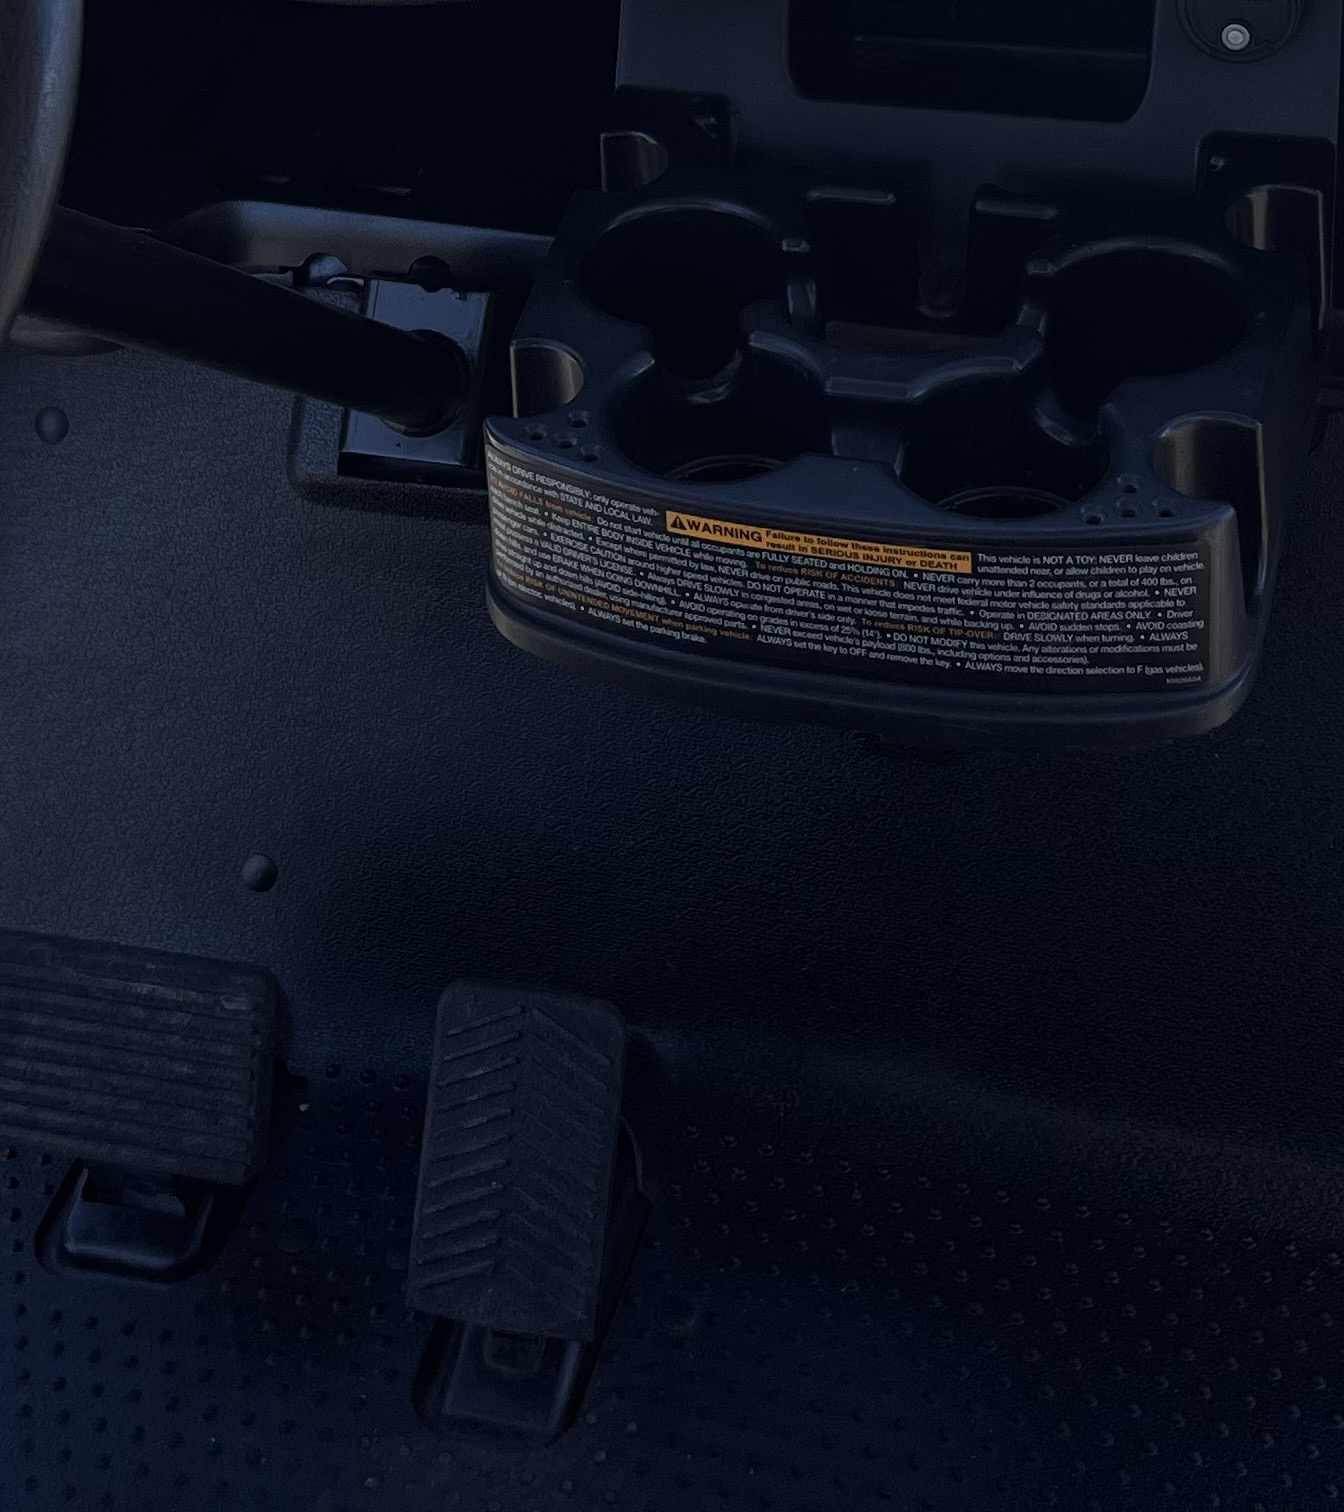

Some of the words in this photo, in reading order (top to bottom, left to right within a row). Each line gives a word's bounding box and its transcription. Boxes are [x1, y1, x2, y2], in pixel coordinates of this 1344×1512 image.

[603, 505, 630, 521] LOCAL
[686, 519, 762, 542] WARNING
[601, 527, 624, 542] BODY
[625, 534, 654, 549] INSIDE
[654, 541, 691, 557] VEHICLE
[903, 581, 935, 593] NEVER
[993, 588, 1020, 598] under
[1164, 586, 1196, 596] NEVER
[765, 529, 800, 542] Failure
[803, 535, 814, 544] to
[816, 537, 848, 549] follow
[851, 542, 879, 553] these
[948, 551, 969, 560] can
[766, 539, 795, 551] result
[810, 546, 859, 560] SERIOUS
[862, 553, 902, 565] INJURY
[919, 559, 957, 569] DEATH
[978, 553, 996, 563] This
[1042, 555, 1064, 564] NOT
[1098, 554, 1132, 564] NEVER
[589, 545, 626, 564] CAUTION
[746, 579, 760, 590] DO
[762, 582, 780, 594] NOT
[783, 585, 825, 600] OPERATE
[1026, 610, 1088, 620] DESIGNATED
[1090, 611, 1123, 620] AREAS
[1124, 610, 1151, 620] ONLY.
[717, 564, 748, 578] NEVER
[841, 583, 859, 594] This
[916, 592, 931, 602] not
[761, 551, 789, 564] FULLY
[791, 556, 827, 570] SEATED
[828, 561, 845, 572] and
[847, 564, 890, 578] HOLDING
[922, 572, 955, 584] NEVER
[956, 577, 980, 587] carry
[981, 578, 1005, 586] more
[1006, 577, 1027, 587] than
[1140, 577, 1158, 586] 400
[1179, 577, 1192, 585] on
[676, 576, 702, 590] DRIVE
[703, 581, 739, 596] SLOWLY
[1028, 621, 1057, 631] AVOID
[1135, 621, 1164, 631] AVOID
[693, 590, 729, 605] ALWAYS
[1003, 630, 1032, 641] DRIVE
[1033, 632, 1073, 642] SLOWLY
[1149, 631, 1188, 641] ALWAYS
[678, 598, 705, 612] AVOID
[892, 632, 907, 642] DO
[908, 633, 929, 645] NOT
[930, 636, 967, 648] MODIFY
[1022, 643, 1039, 655] Any
[760, 623, 790, 636] NEVER
[756, 632, 792, 647] ALWAYS
[849, 646, 867, 658] OFF
[964, 660, 1002, 672] ALWAYS
